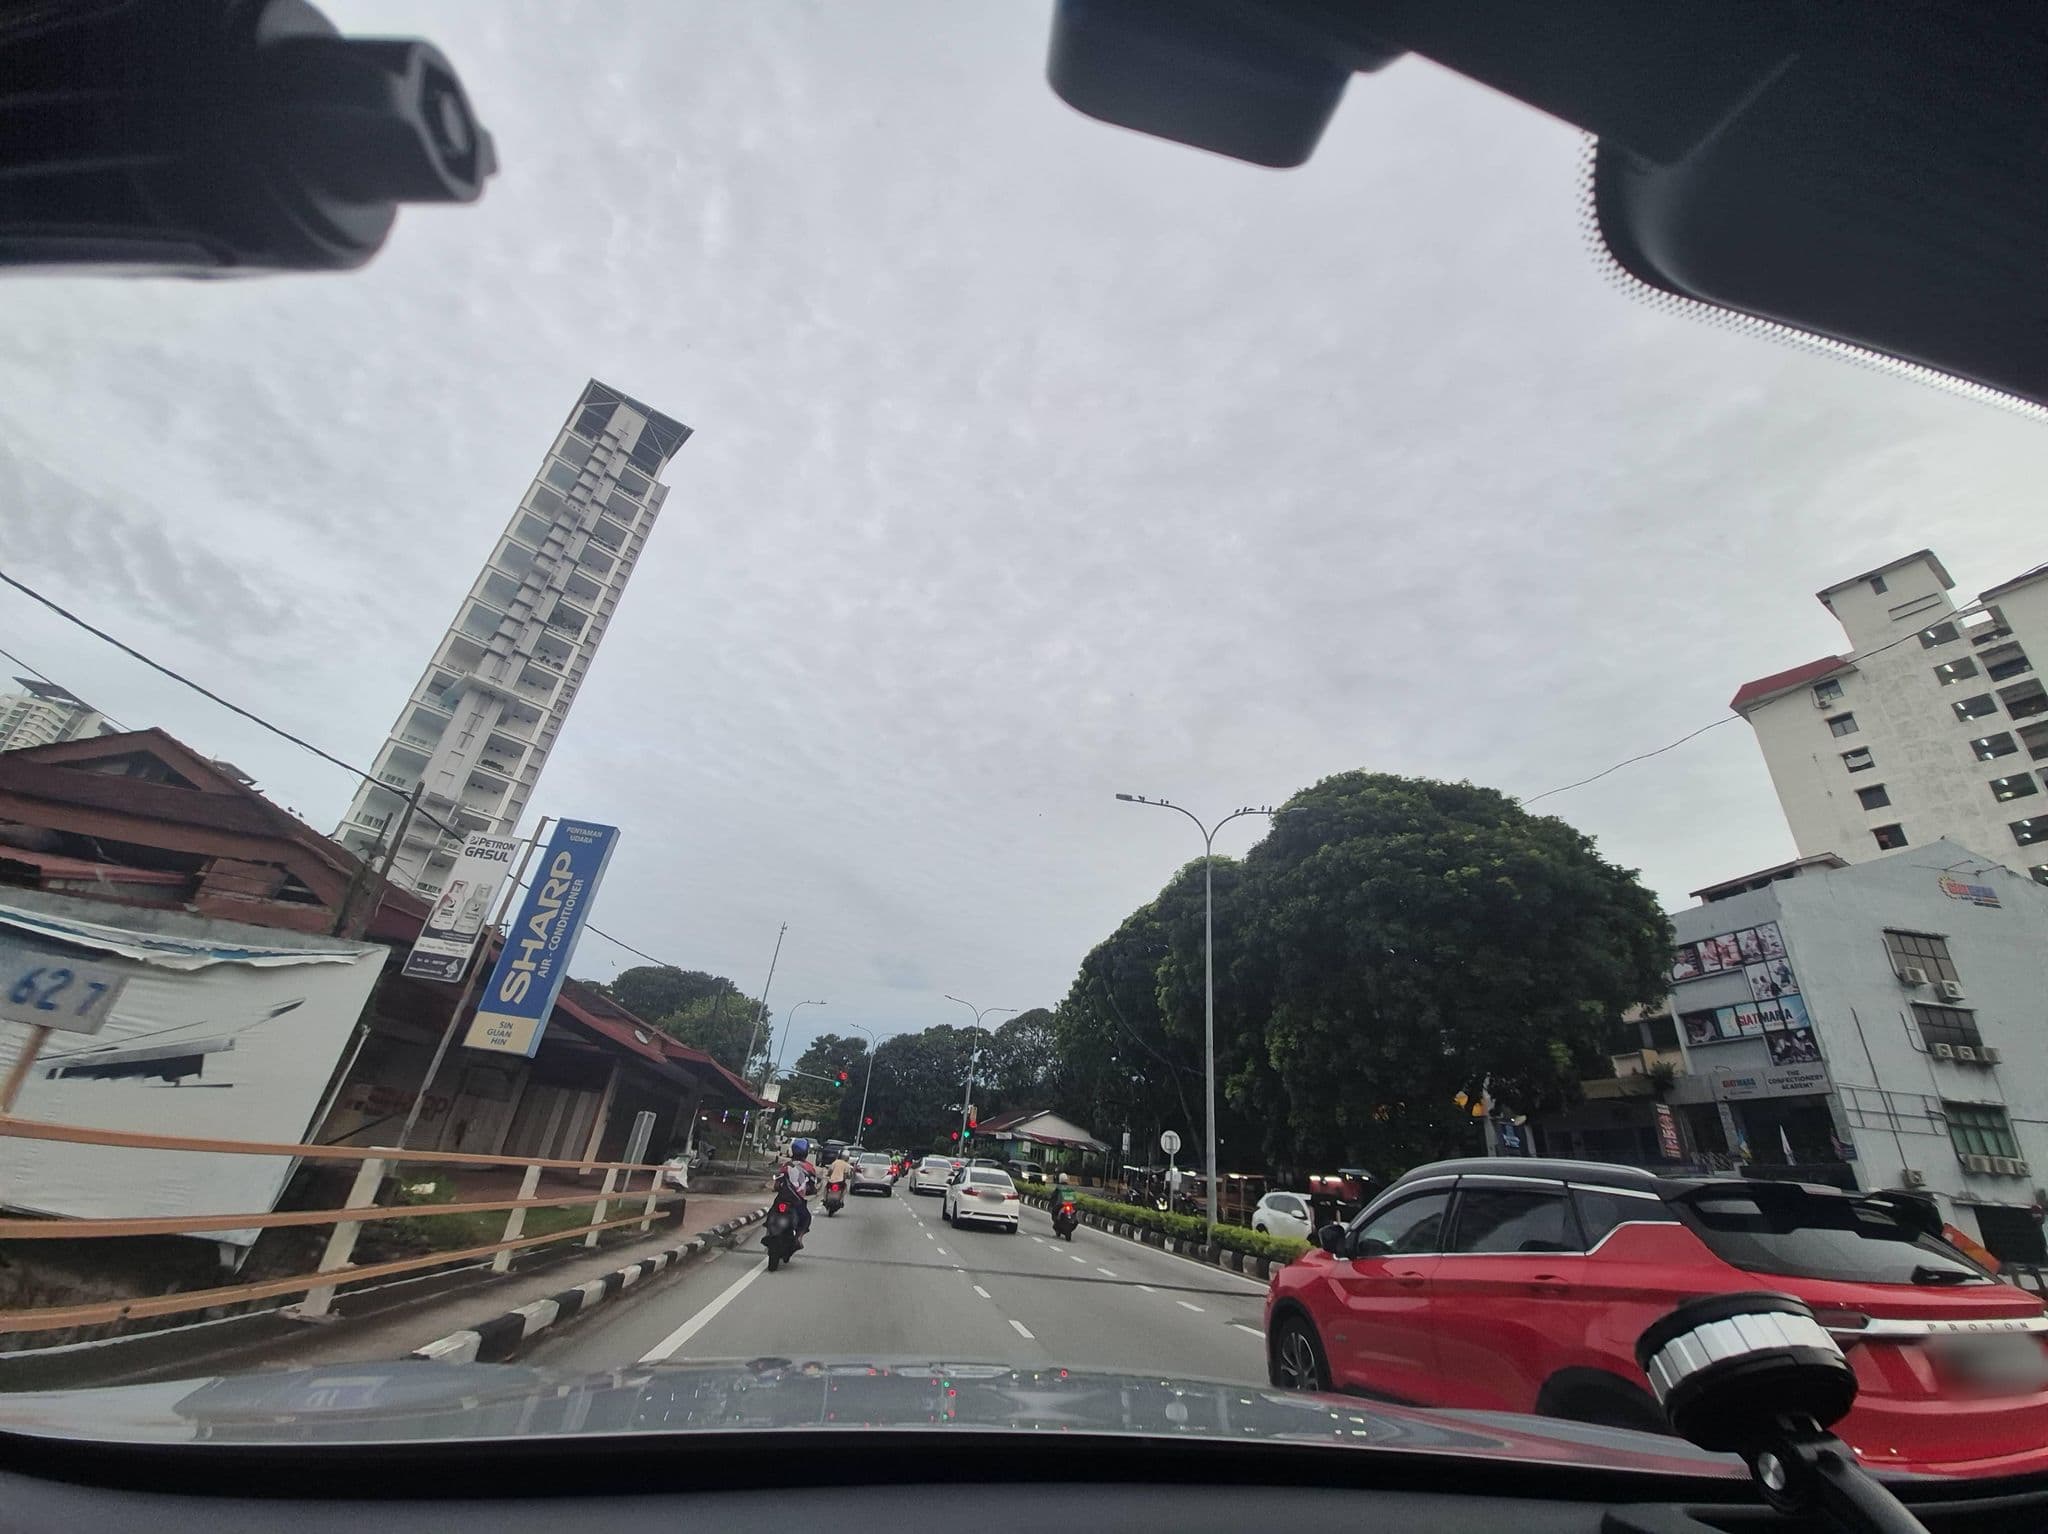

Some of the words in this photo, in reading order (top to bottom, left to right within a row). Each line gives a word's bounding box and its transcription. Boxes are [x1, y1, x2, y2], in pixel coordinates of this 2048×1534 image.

[478, 837, 516, 851] PETRON
[464, 846, 509, 863] GASUL
[500, 850, 574, 1005] SHARP
[499, 1021, 514, 1030] SIN
[487, 1028, 513, 1038] GUAN
[490, 1037, 507, 1046] HIN
[1927, 1321, 2029, 1332] PROTON
